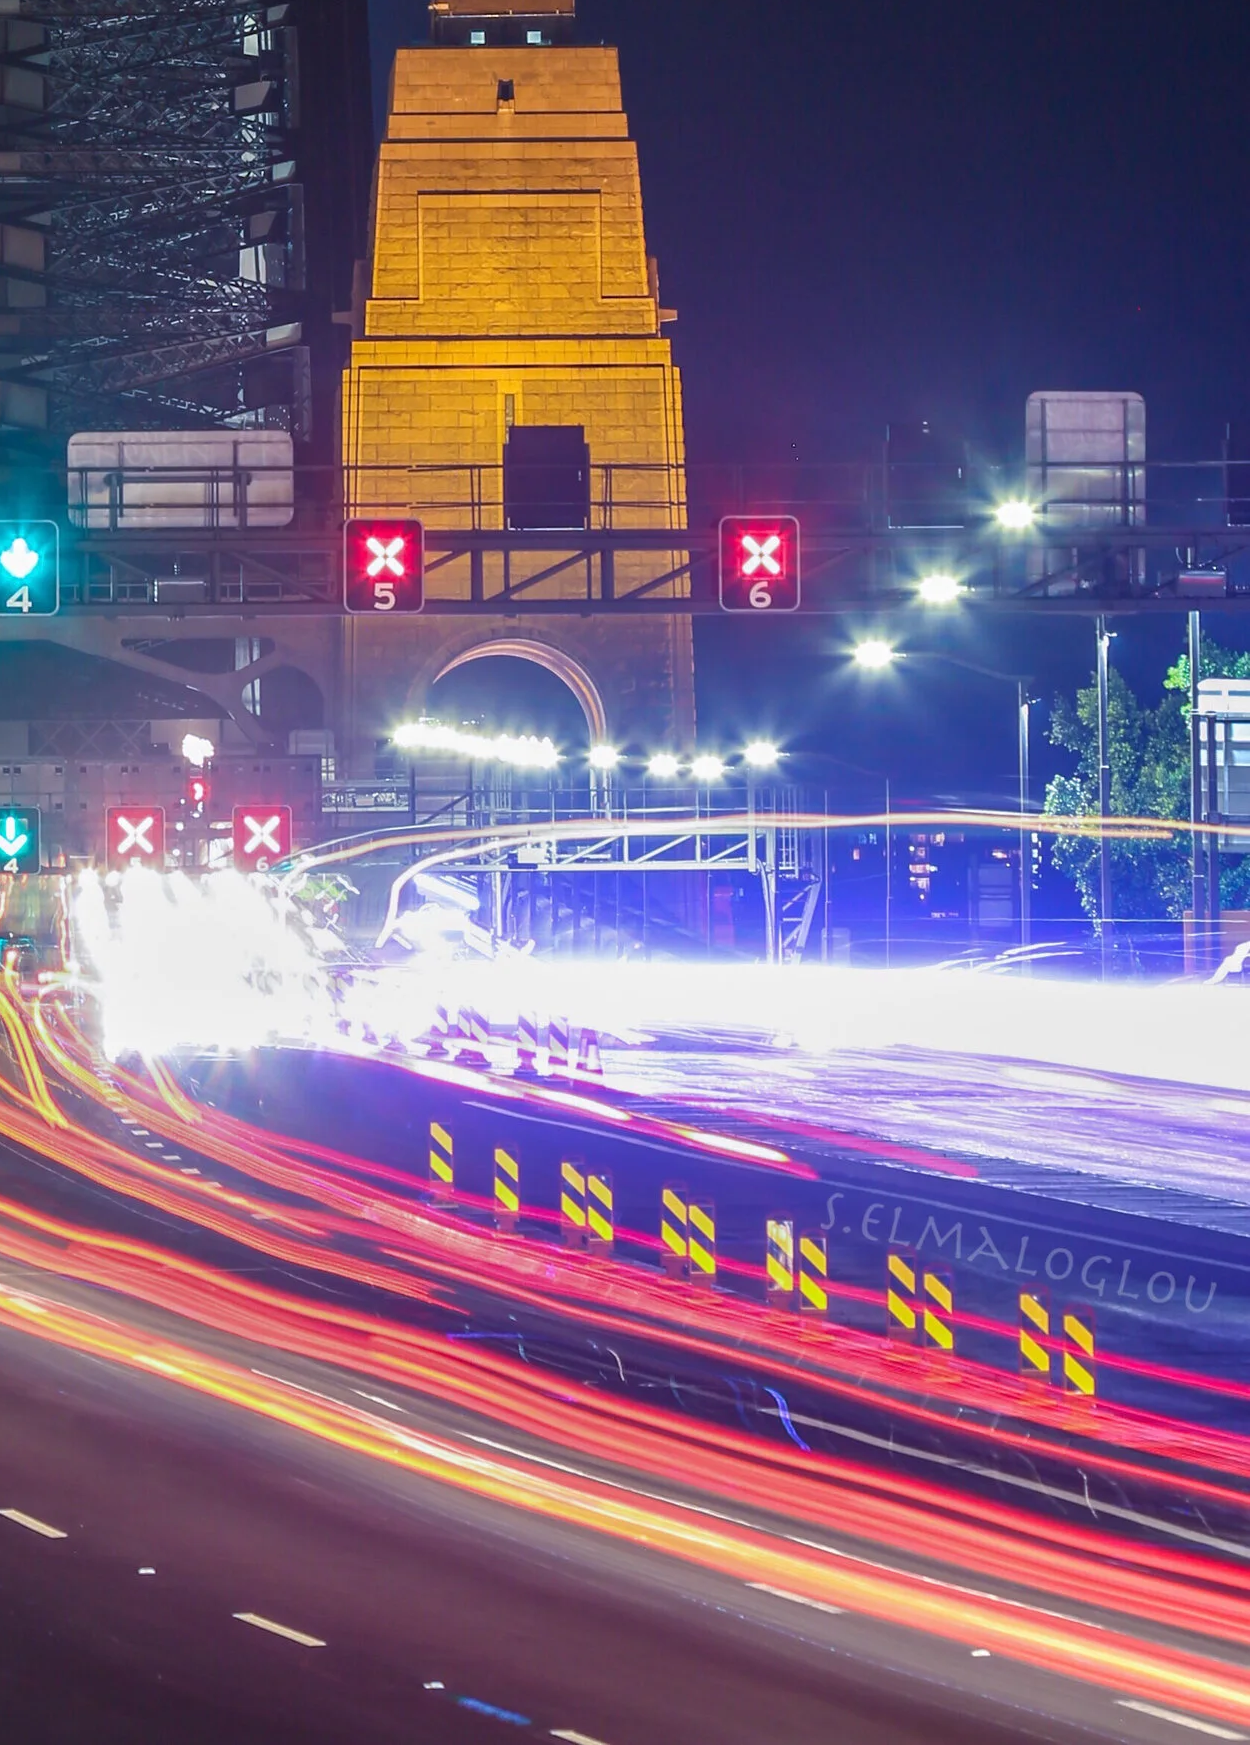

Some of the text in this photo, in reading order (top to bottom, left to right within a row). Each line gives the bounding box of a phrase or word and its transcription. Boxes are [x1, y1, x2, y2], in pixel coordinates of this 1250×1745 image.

[6, 585, 32, 613] 4
[373, 582, 396, 611] 5
[749, 581, 772, 609] 6
[3, 857, 19, 874] 4
[256, 856, 269, 872] 6
